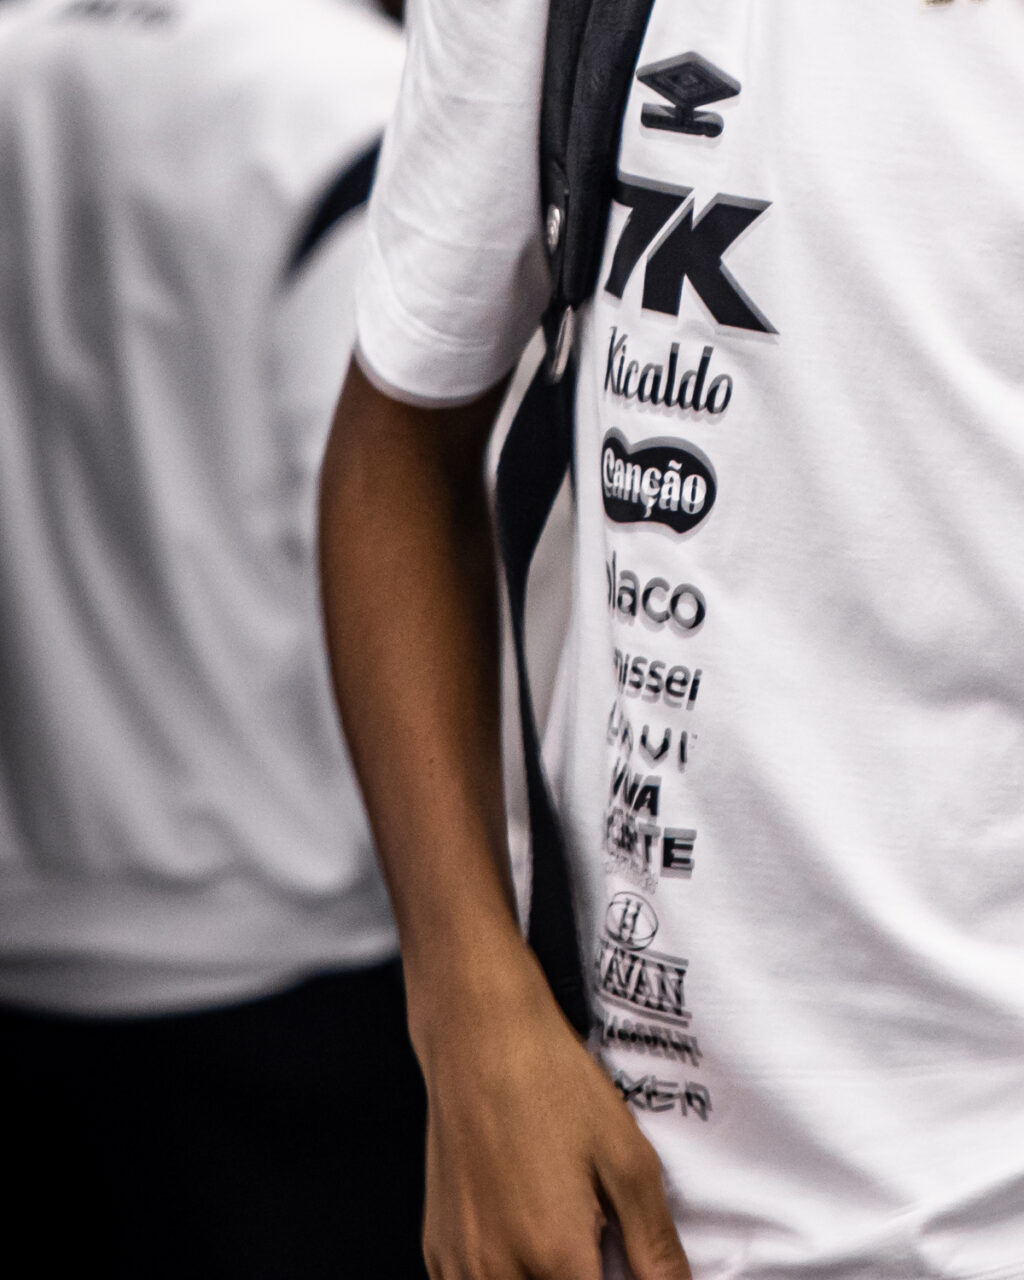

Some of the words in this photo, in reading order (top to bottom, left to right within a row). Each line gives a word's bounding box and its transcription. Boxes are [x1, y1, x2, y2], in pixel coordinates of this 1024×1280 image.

[606, 172, 780, 336] 7K
[604, 326, 733, 415] Kicaldo
[603, 447, 707, 518] Canção
